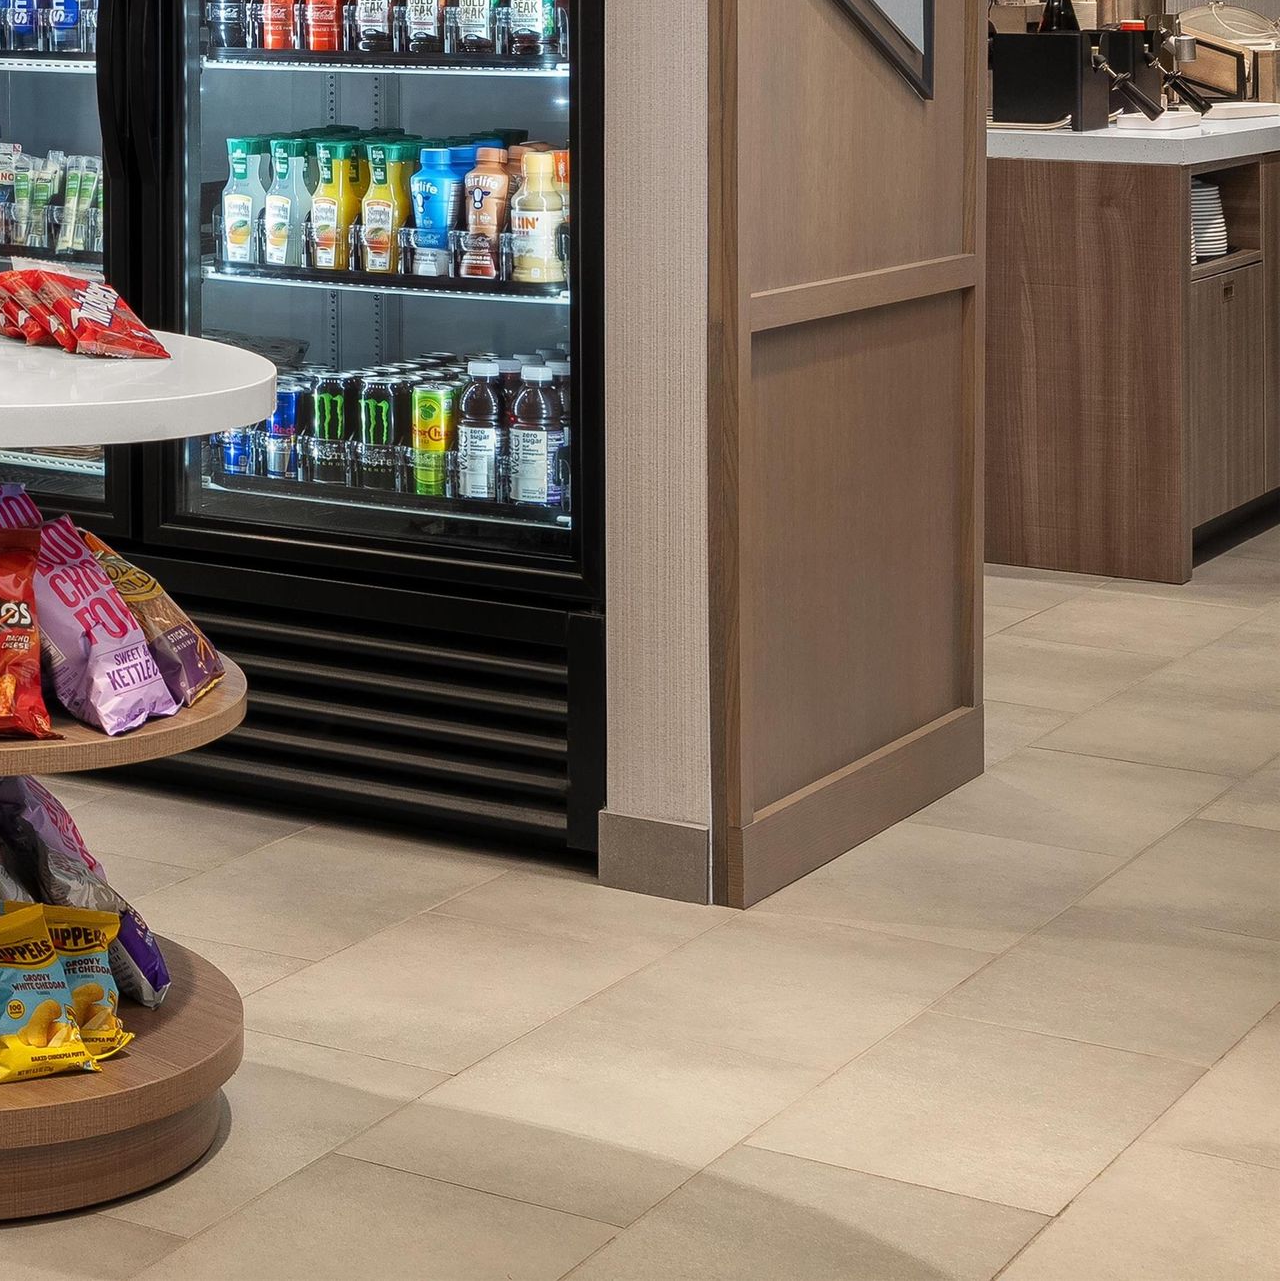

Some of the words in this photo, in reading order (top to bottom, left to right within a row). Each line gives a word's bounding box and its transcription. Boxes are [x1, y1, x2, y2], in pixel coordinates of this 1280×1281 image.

[5, 634, 30, 643] NACHO
[167, 627, 189, 643] STICKS
[1, 641, 31, 650] CHEESE
[113, 650, 143, 667] SWEET
[22, 973, 51, 983] GROOVY
[11, 982, 37, 992] WHITE
[36, 980, 67, 990] CHEDDAR
